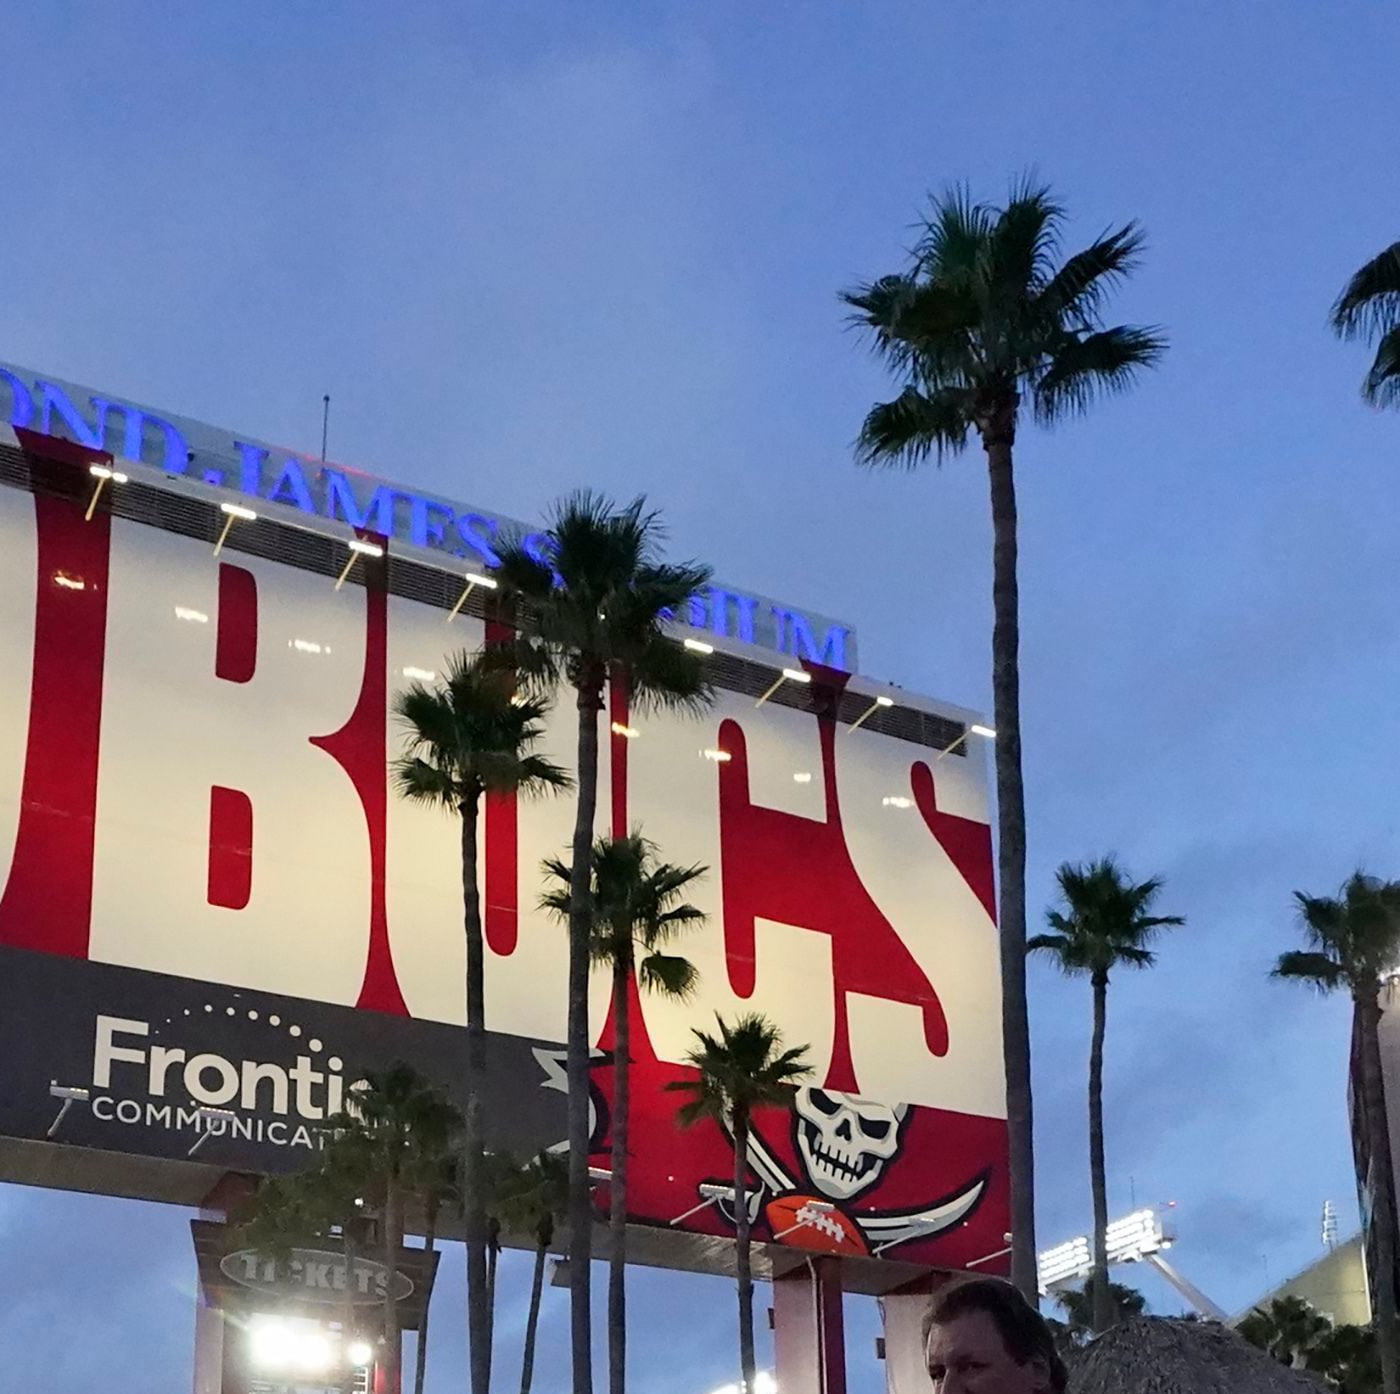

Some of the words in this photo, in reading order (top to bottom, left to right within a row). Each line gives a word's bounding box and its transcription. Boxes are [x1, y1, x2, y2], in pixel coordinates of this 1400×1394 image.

[203, 441, 502, 568] JAMES
[521, 532, 851, 673] SIUM
[88, 455, 1008, 1118] BUCS
[92, 1013, 378, 1128] Fronti
[92, 1096, 348, 1152] COMMUNICAT
